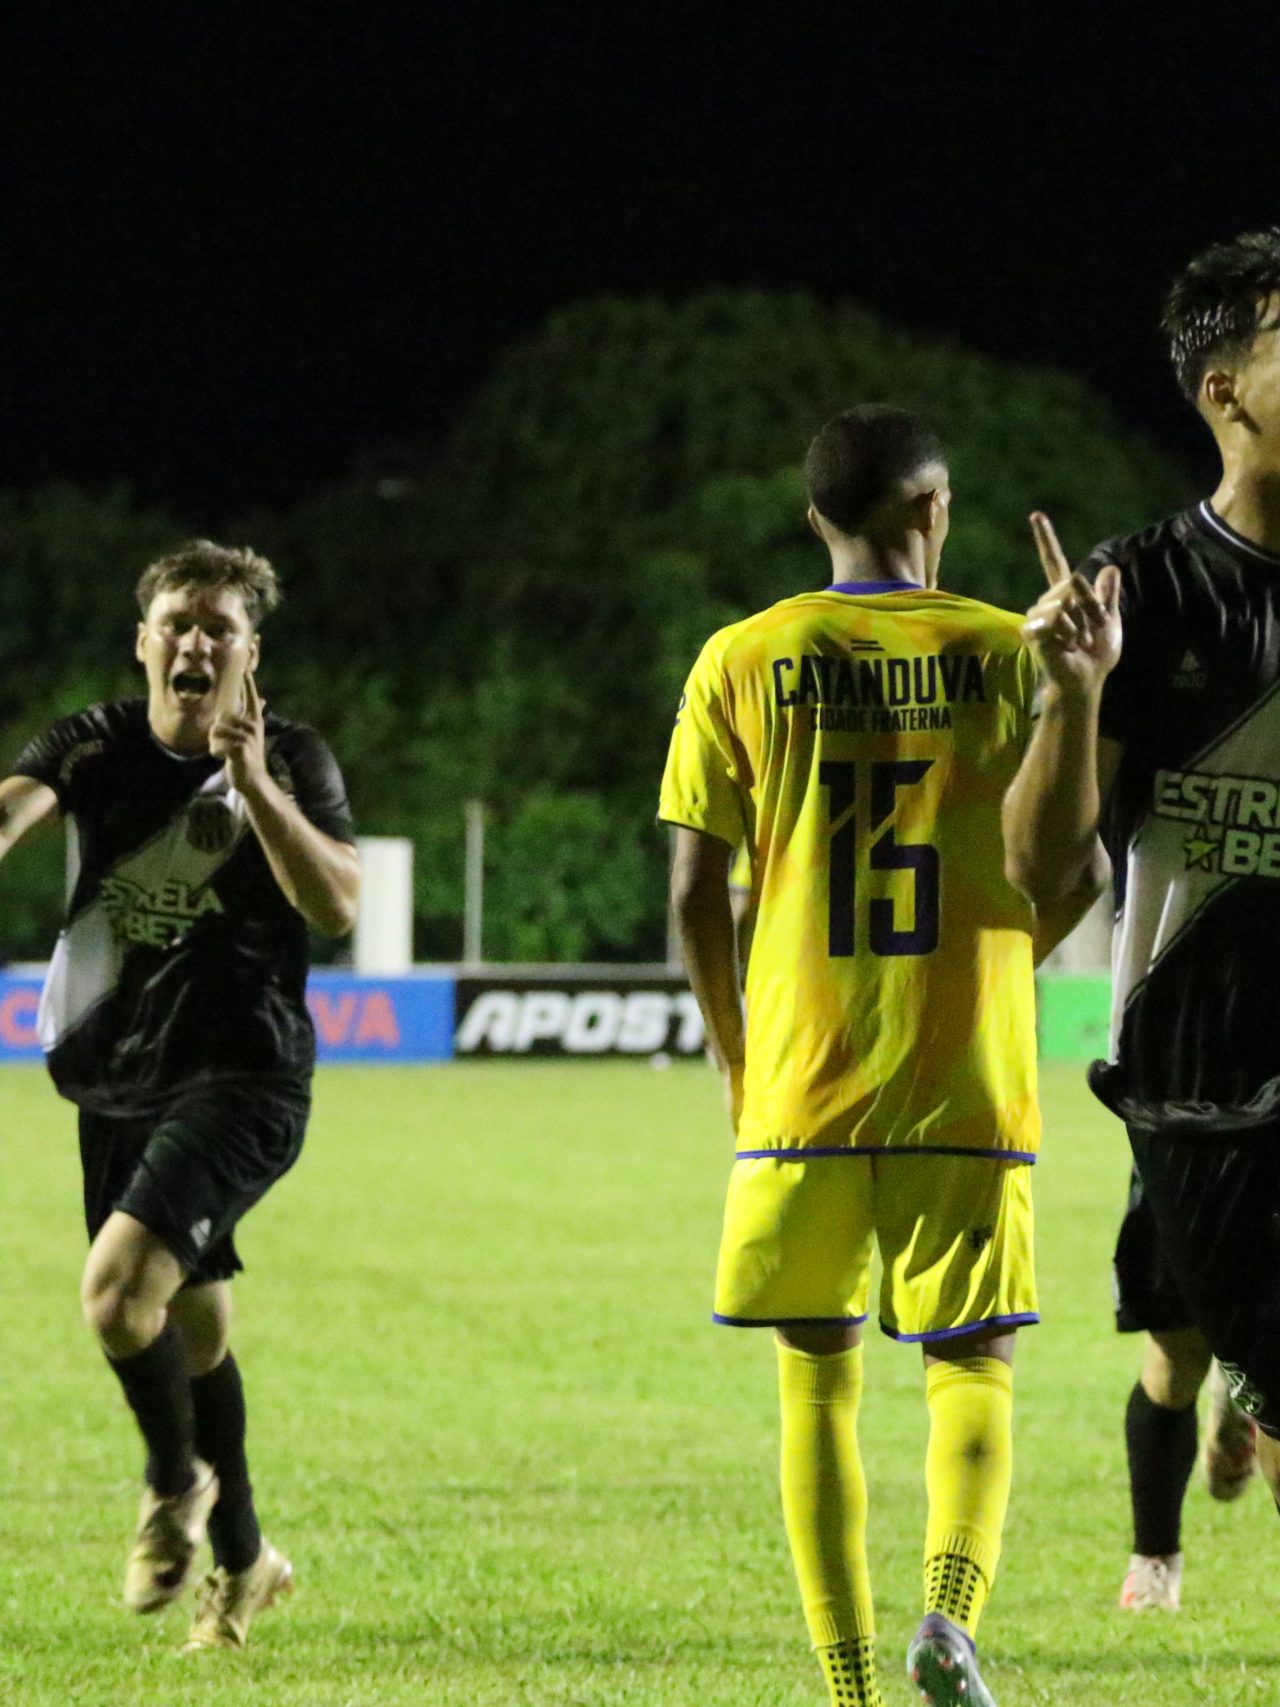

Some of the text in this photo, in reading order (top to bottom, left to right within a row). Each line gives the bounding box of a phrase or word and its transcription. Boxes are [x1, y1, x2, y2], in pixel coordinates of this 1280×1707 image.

[772, 654, 987, 707] CATANDUVA
[871, 707, 952, 732] FRATERNA
[819, 761, 940, 957] 15
